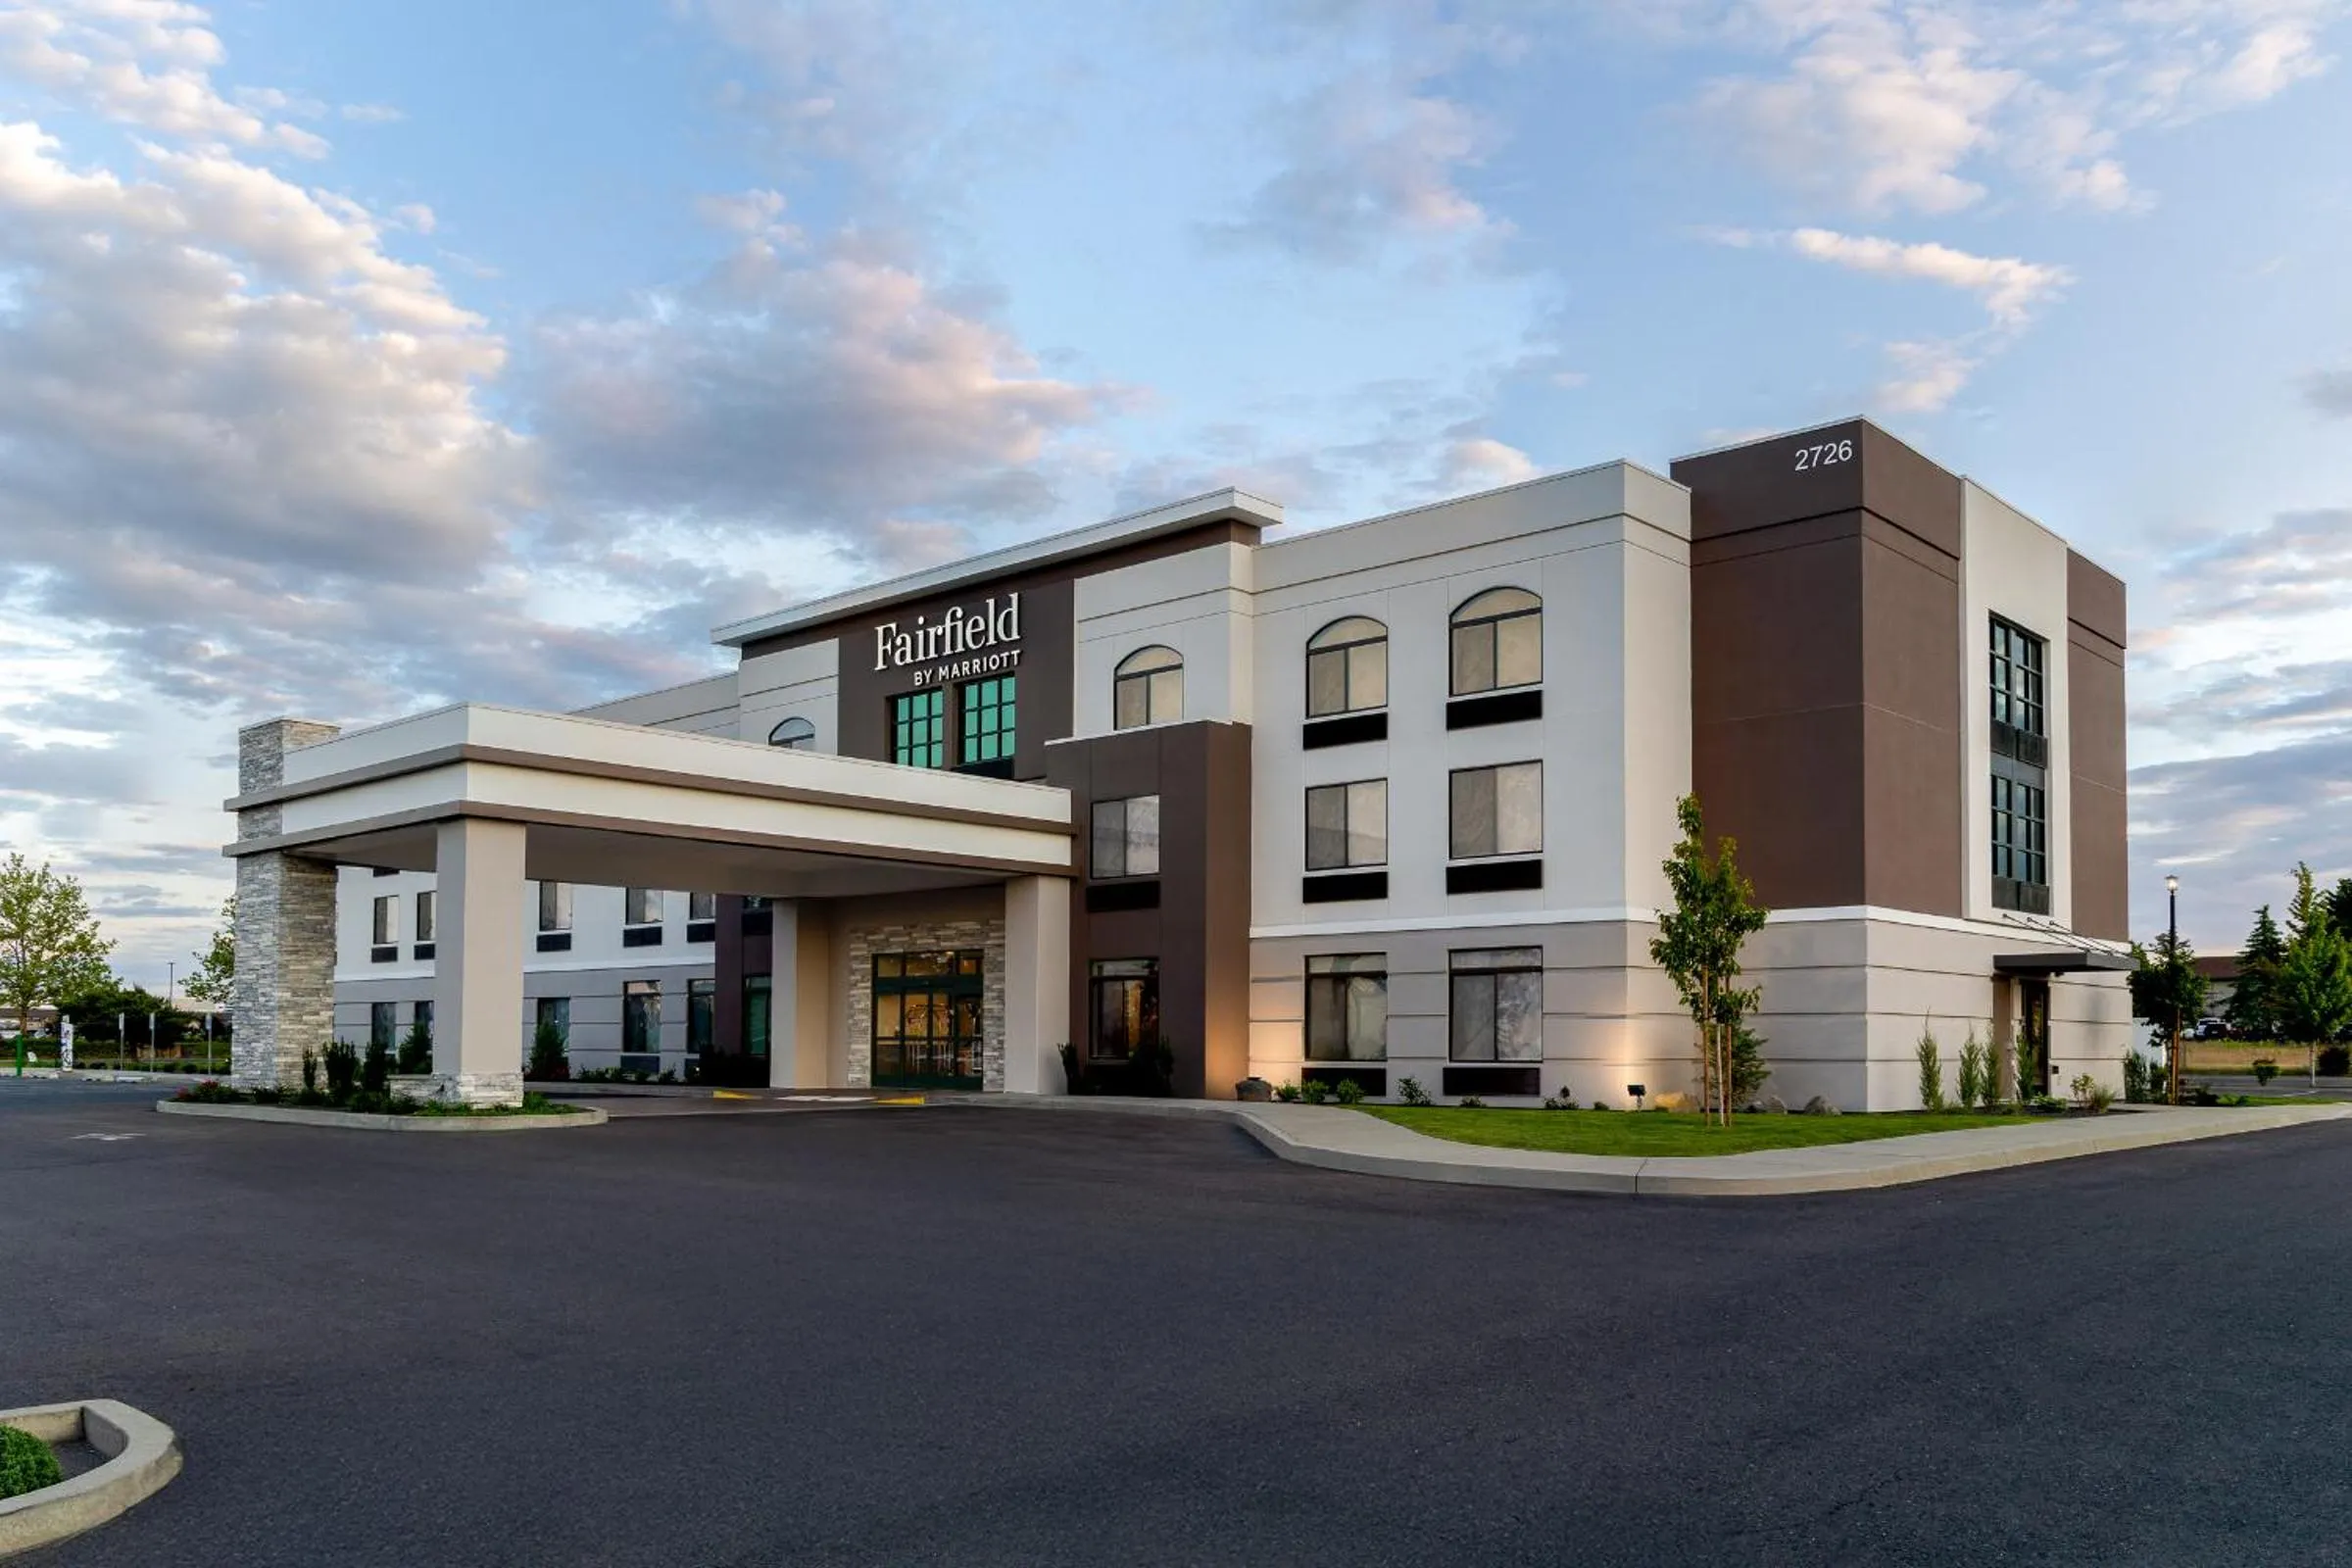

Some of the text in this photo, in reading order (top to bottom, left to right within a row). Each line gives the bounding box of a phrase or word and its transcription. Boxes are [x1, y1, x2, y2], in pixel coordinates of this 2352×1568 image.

[1794, 439, 1853, 471] 2726
[874, 592, 1021, 670] Fairfield
[913, 650, 1021, 686] BY MARRIOTT
